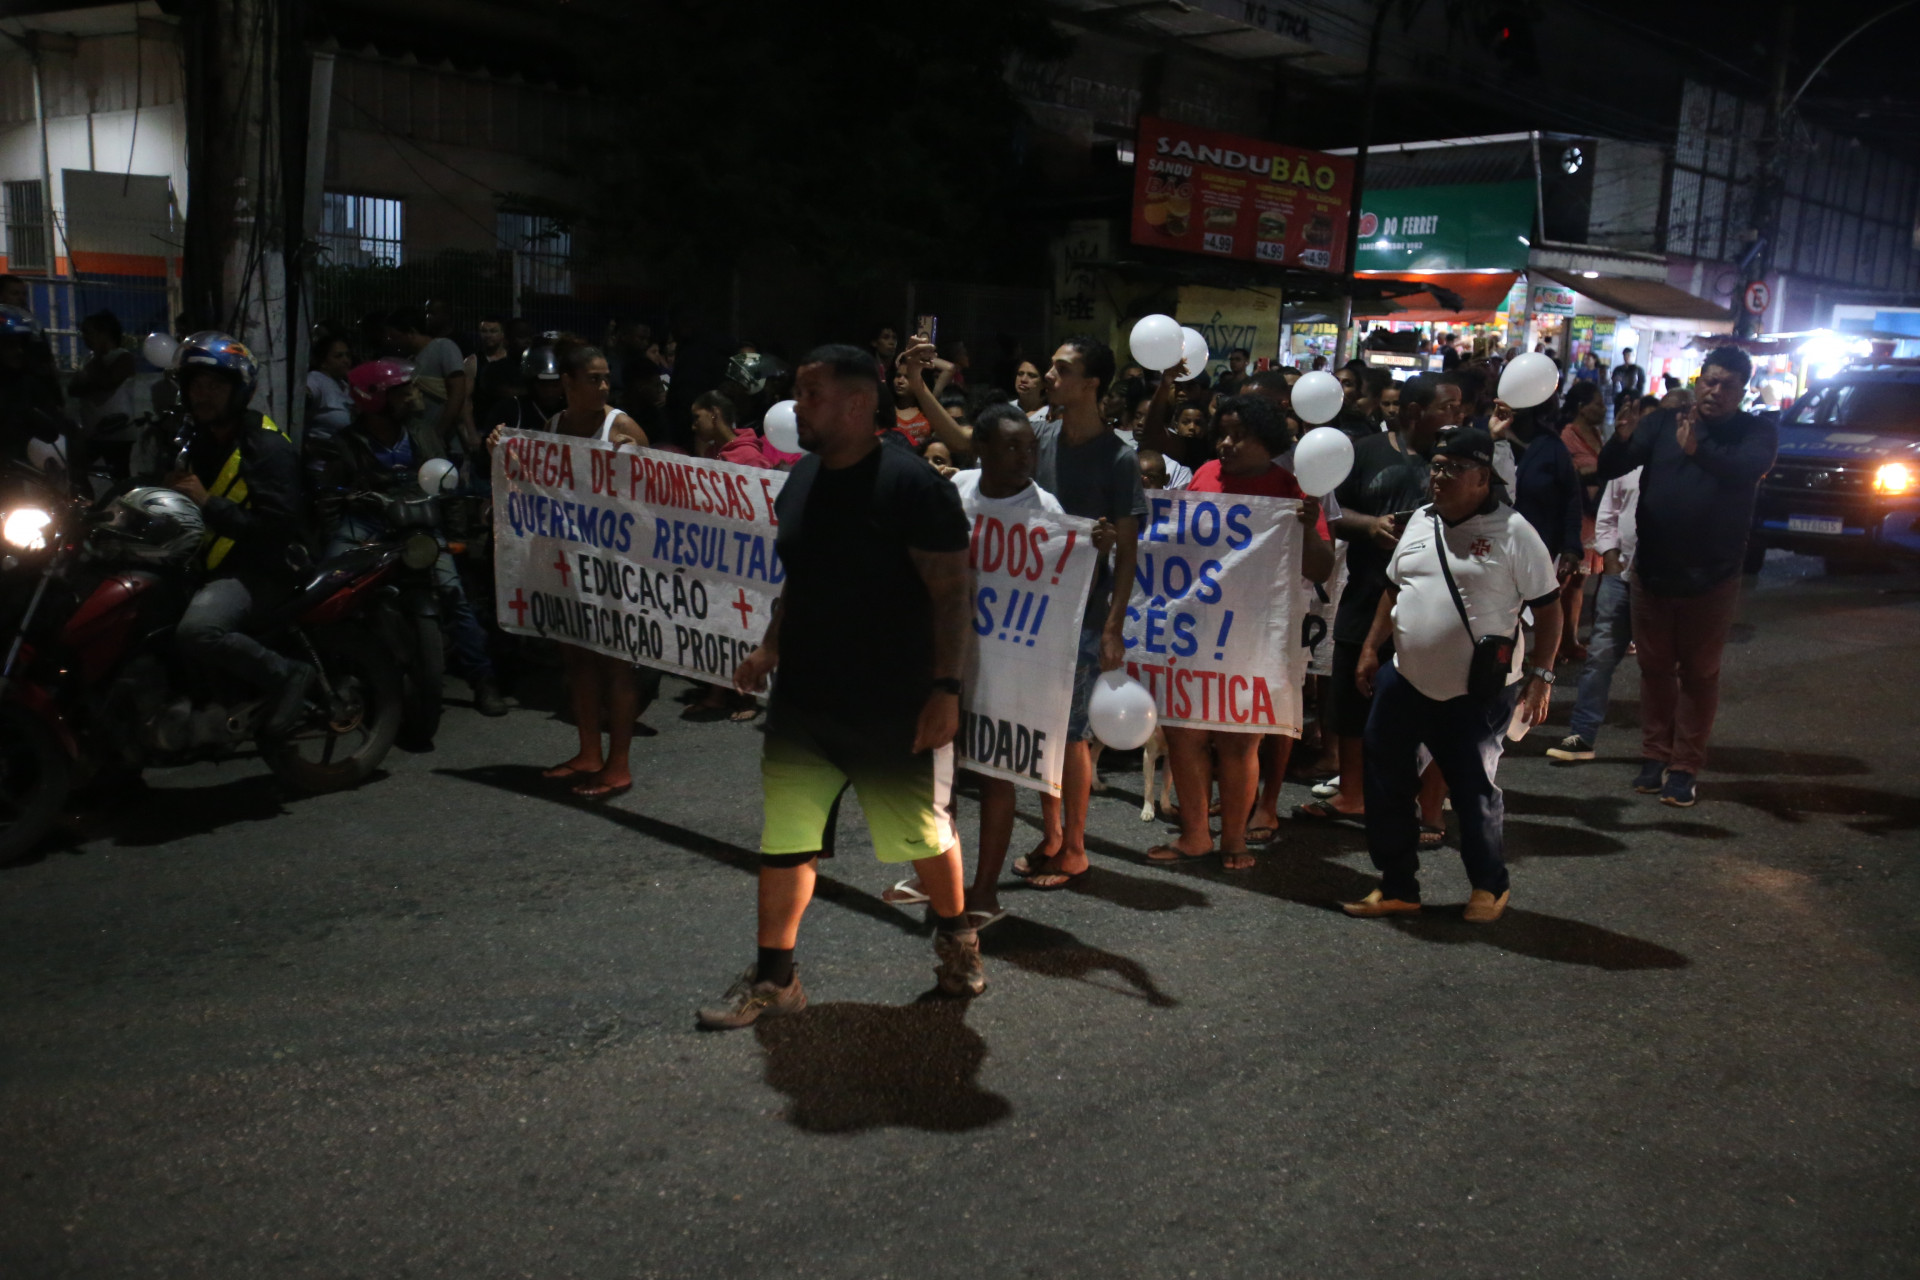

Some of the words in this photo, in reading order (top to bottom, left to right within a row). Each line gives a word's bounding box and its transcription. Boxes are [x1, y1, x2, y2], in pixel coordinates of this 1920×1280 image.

[1145, 173, 1196, 199] BÃO
[1147, 158, 1192, 178] SANDU
[1156, 136, 1336, 191] SANDUBÃO
[1383, 217, 1398, 236] DO
[1402, 215, 1439, 235] FERRET
[504, 437, 575, 490] CHEGA
[592, 450, 617, 497] DE
[630, 454, 755, 521] PROMESSAS
[760, 478, 781, 526] E
[508, 491, 635, 552] QUEREMOS
[1138, 498, 1253, 550] EIOS
[578, 553, 708, 620] EDUCAÇÃO
[530, 591, 662, 661] QUALIFICAÇÃO
